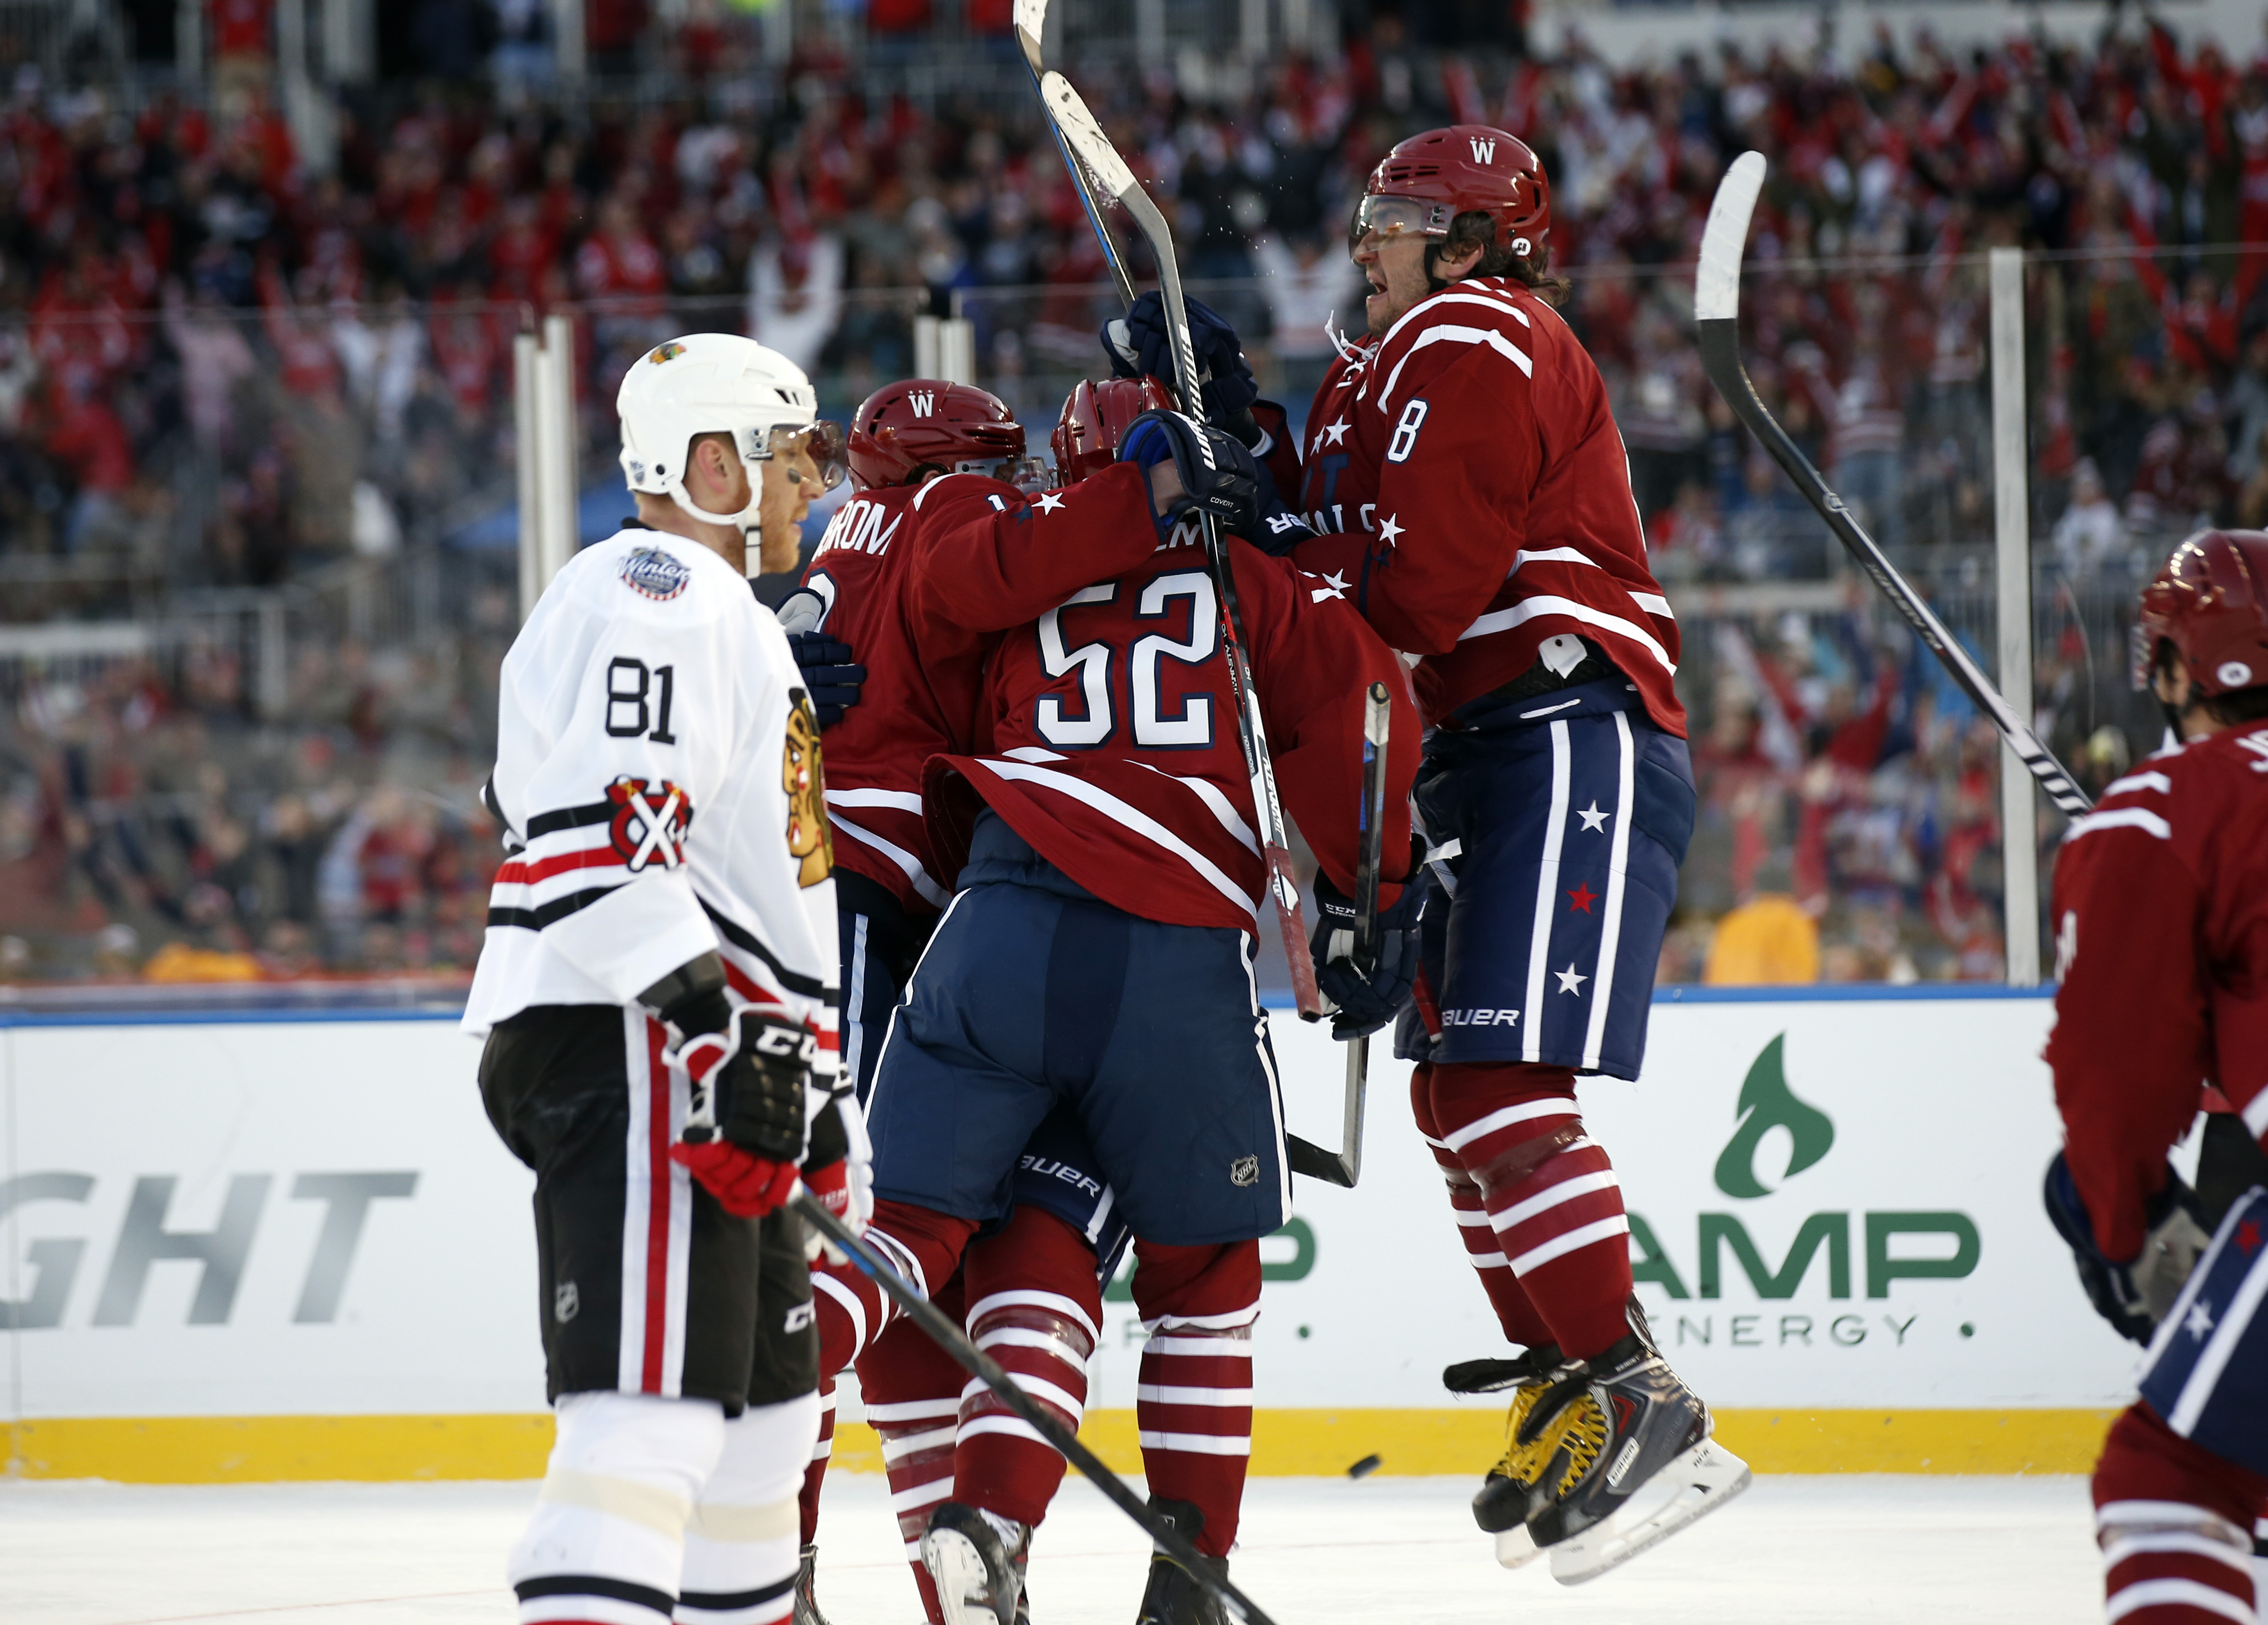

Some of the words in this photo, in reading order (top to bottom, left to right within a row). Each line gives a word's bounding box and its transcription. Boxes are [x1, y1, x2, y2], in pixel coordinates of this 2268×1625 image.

[1469, 137, 1496, 165] W
[907, 390, 935, 418] W
[1387, 397, 1429, 464] 8
[1210, 496, 1234, 508] COVERT
[1038, 571, 1218, 745] 52
[605, 657, 676, 745] 81
[1260, 756, 1283, 834] DYNASTY
[1325, 902, 1356, 915] CCM
[0, 1170, 423, 1330] GHT
